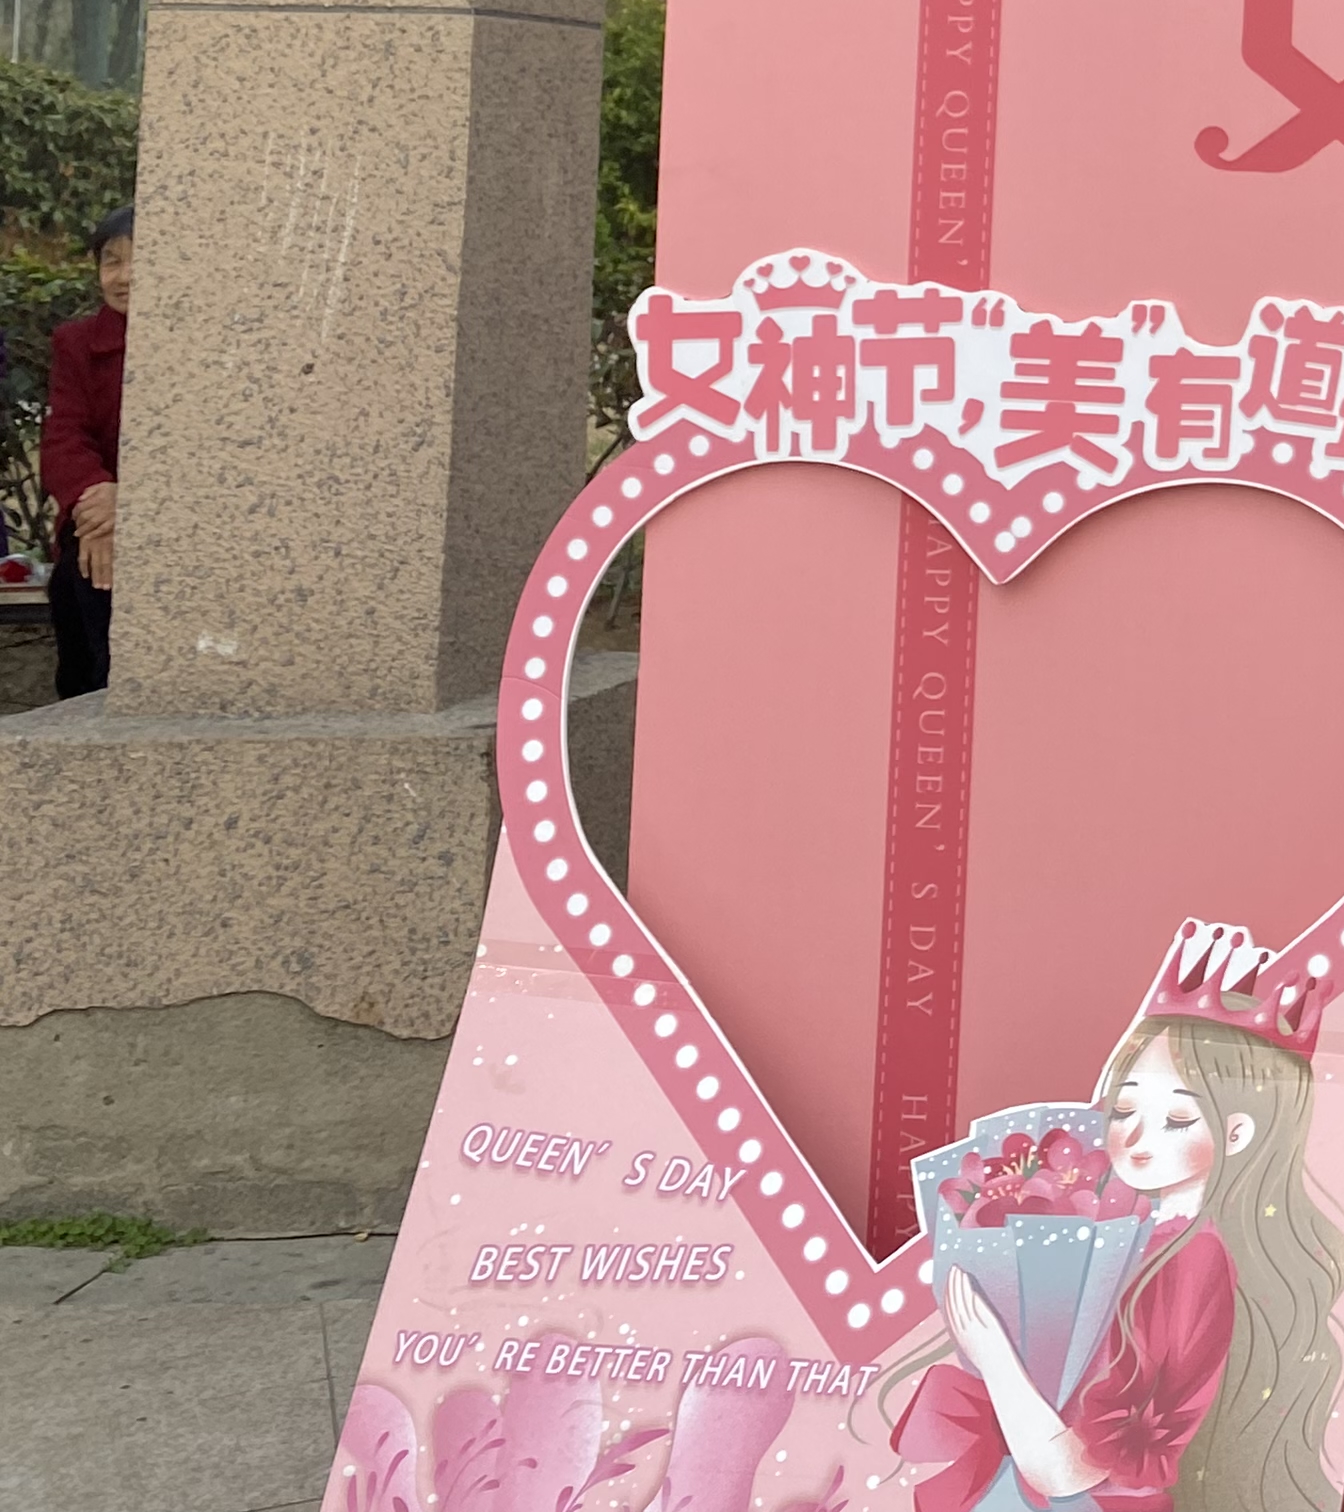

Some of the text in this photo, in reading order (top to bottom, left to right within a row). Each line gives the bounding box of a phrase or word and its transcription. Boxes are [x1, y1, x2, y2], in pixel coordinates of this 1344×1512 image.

[922, 519, 952, 646] APPY
[907, 925, 936, 1016] DAY
[659, 1157, 746, 1202] DAY
[471, 1245, 732, 1284] BEST WISHES
[546, 1342, 673, 1384] BETTER
[681, 1352, 776, 1391] THAN
[788, 1360, 880, 1397] THAT
